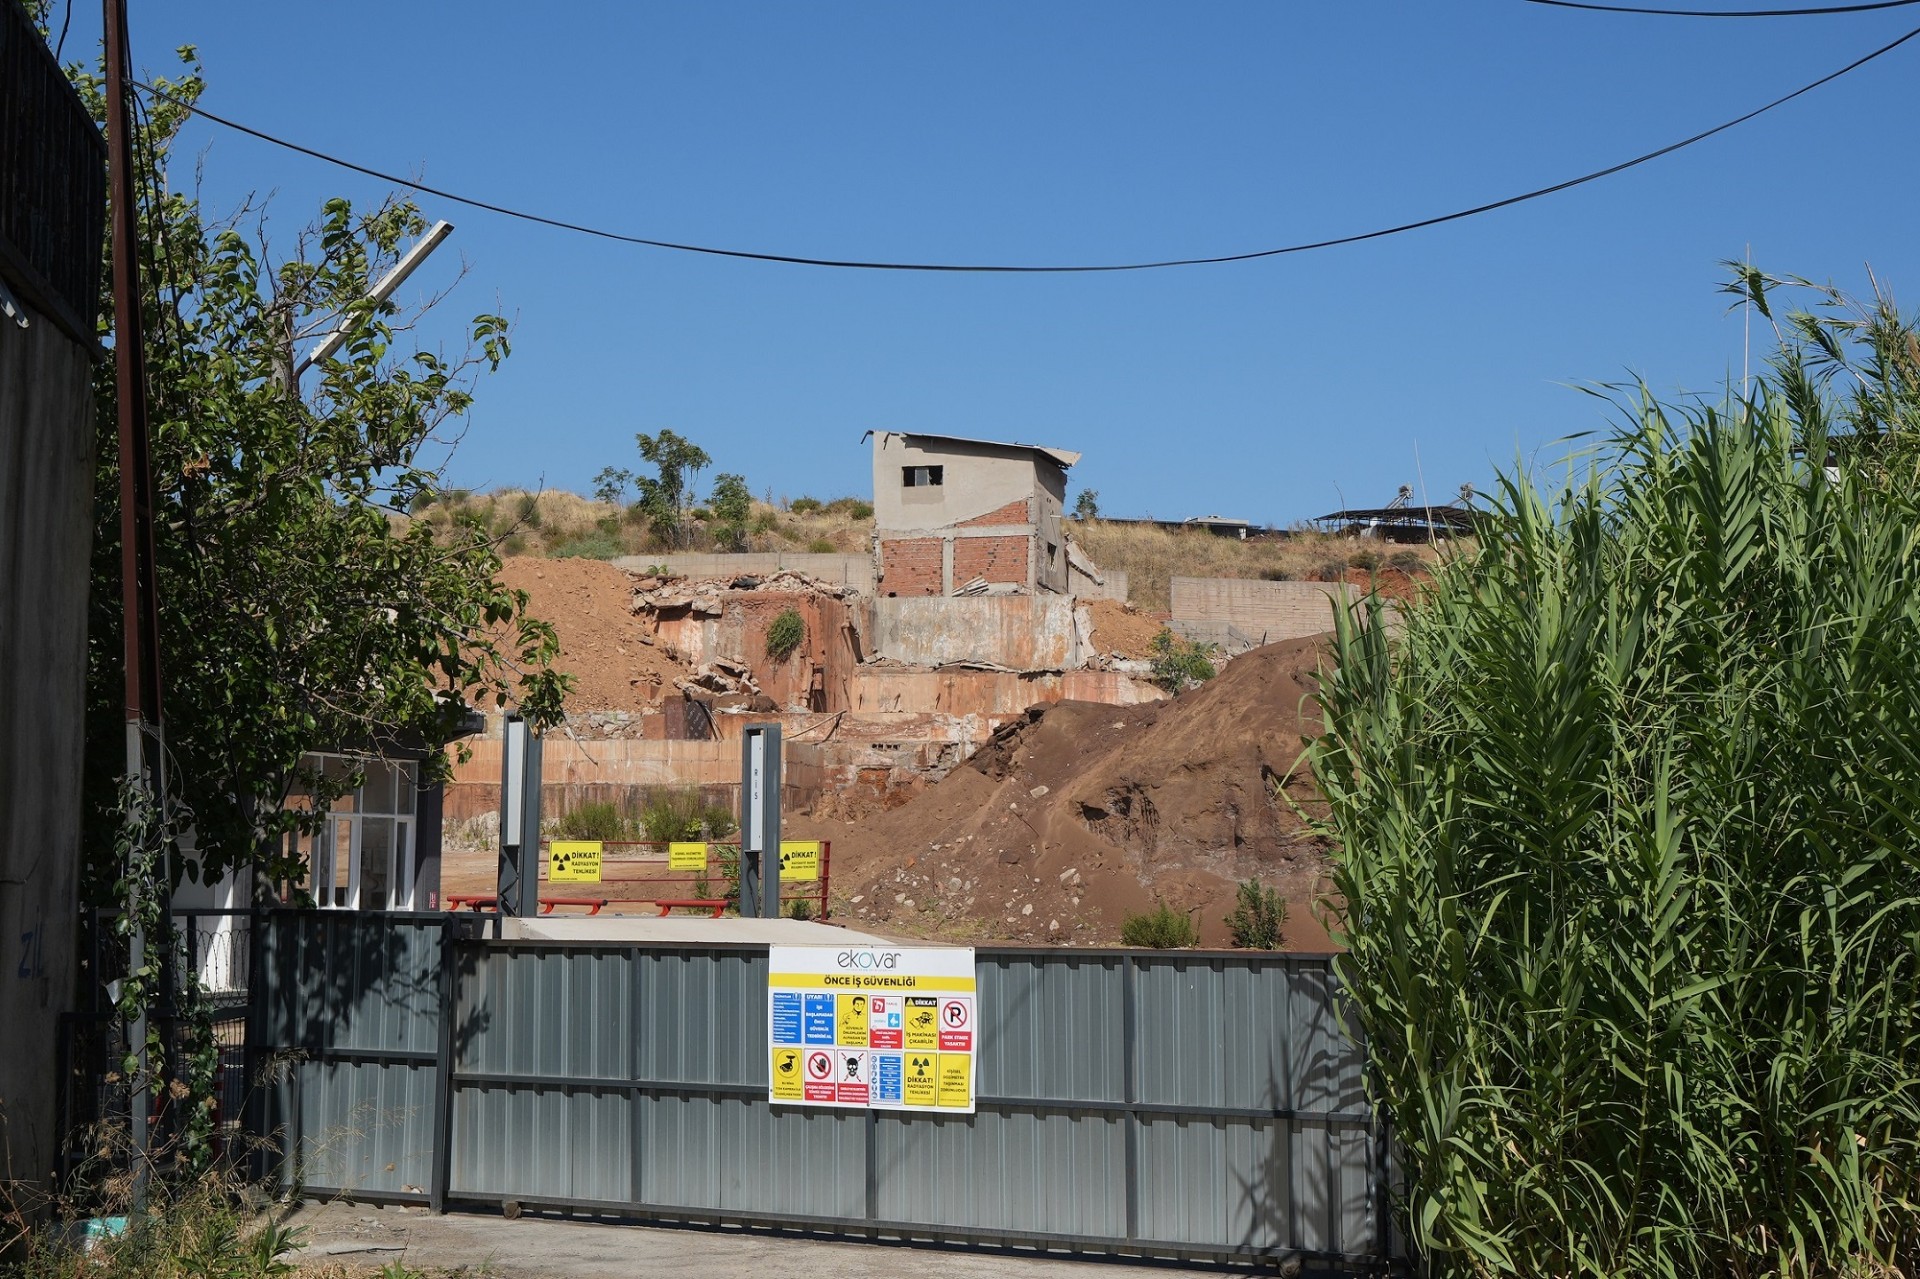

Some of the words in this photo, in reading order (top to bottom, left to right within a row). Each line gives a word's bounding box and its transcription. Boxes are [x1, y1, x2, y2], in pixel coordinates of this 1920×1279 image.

[837, 949, 902, 969] ekovar
[824, 974, 850, 985] ÖNCE
[852, 975, 861, 988] İŞ
[863, 975, 916, 987] GÜVENLİĞİ
